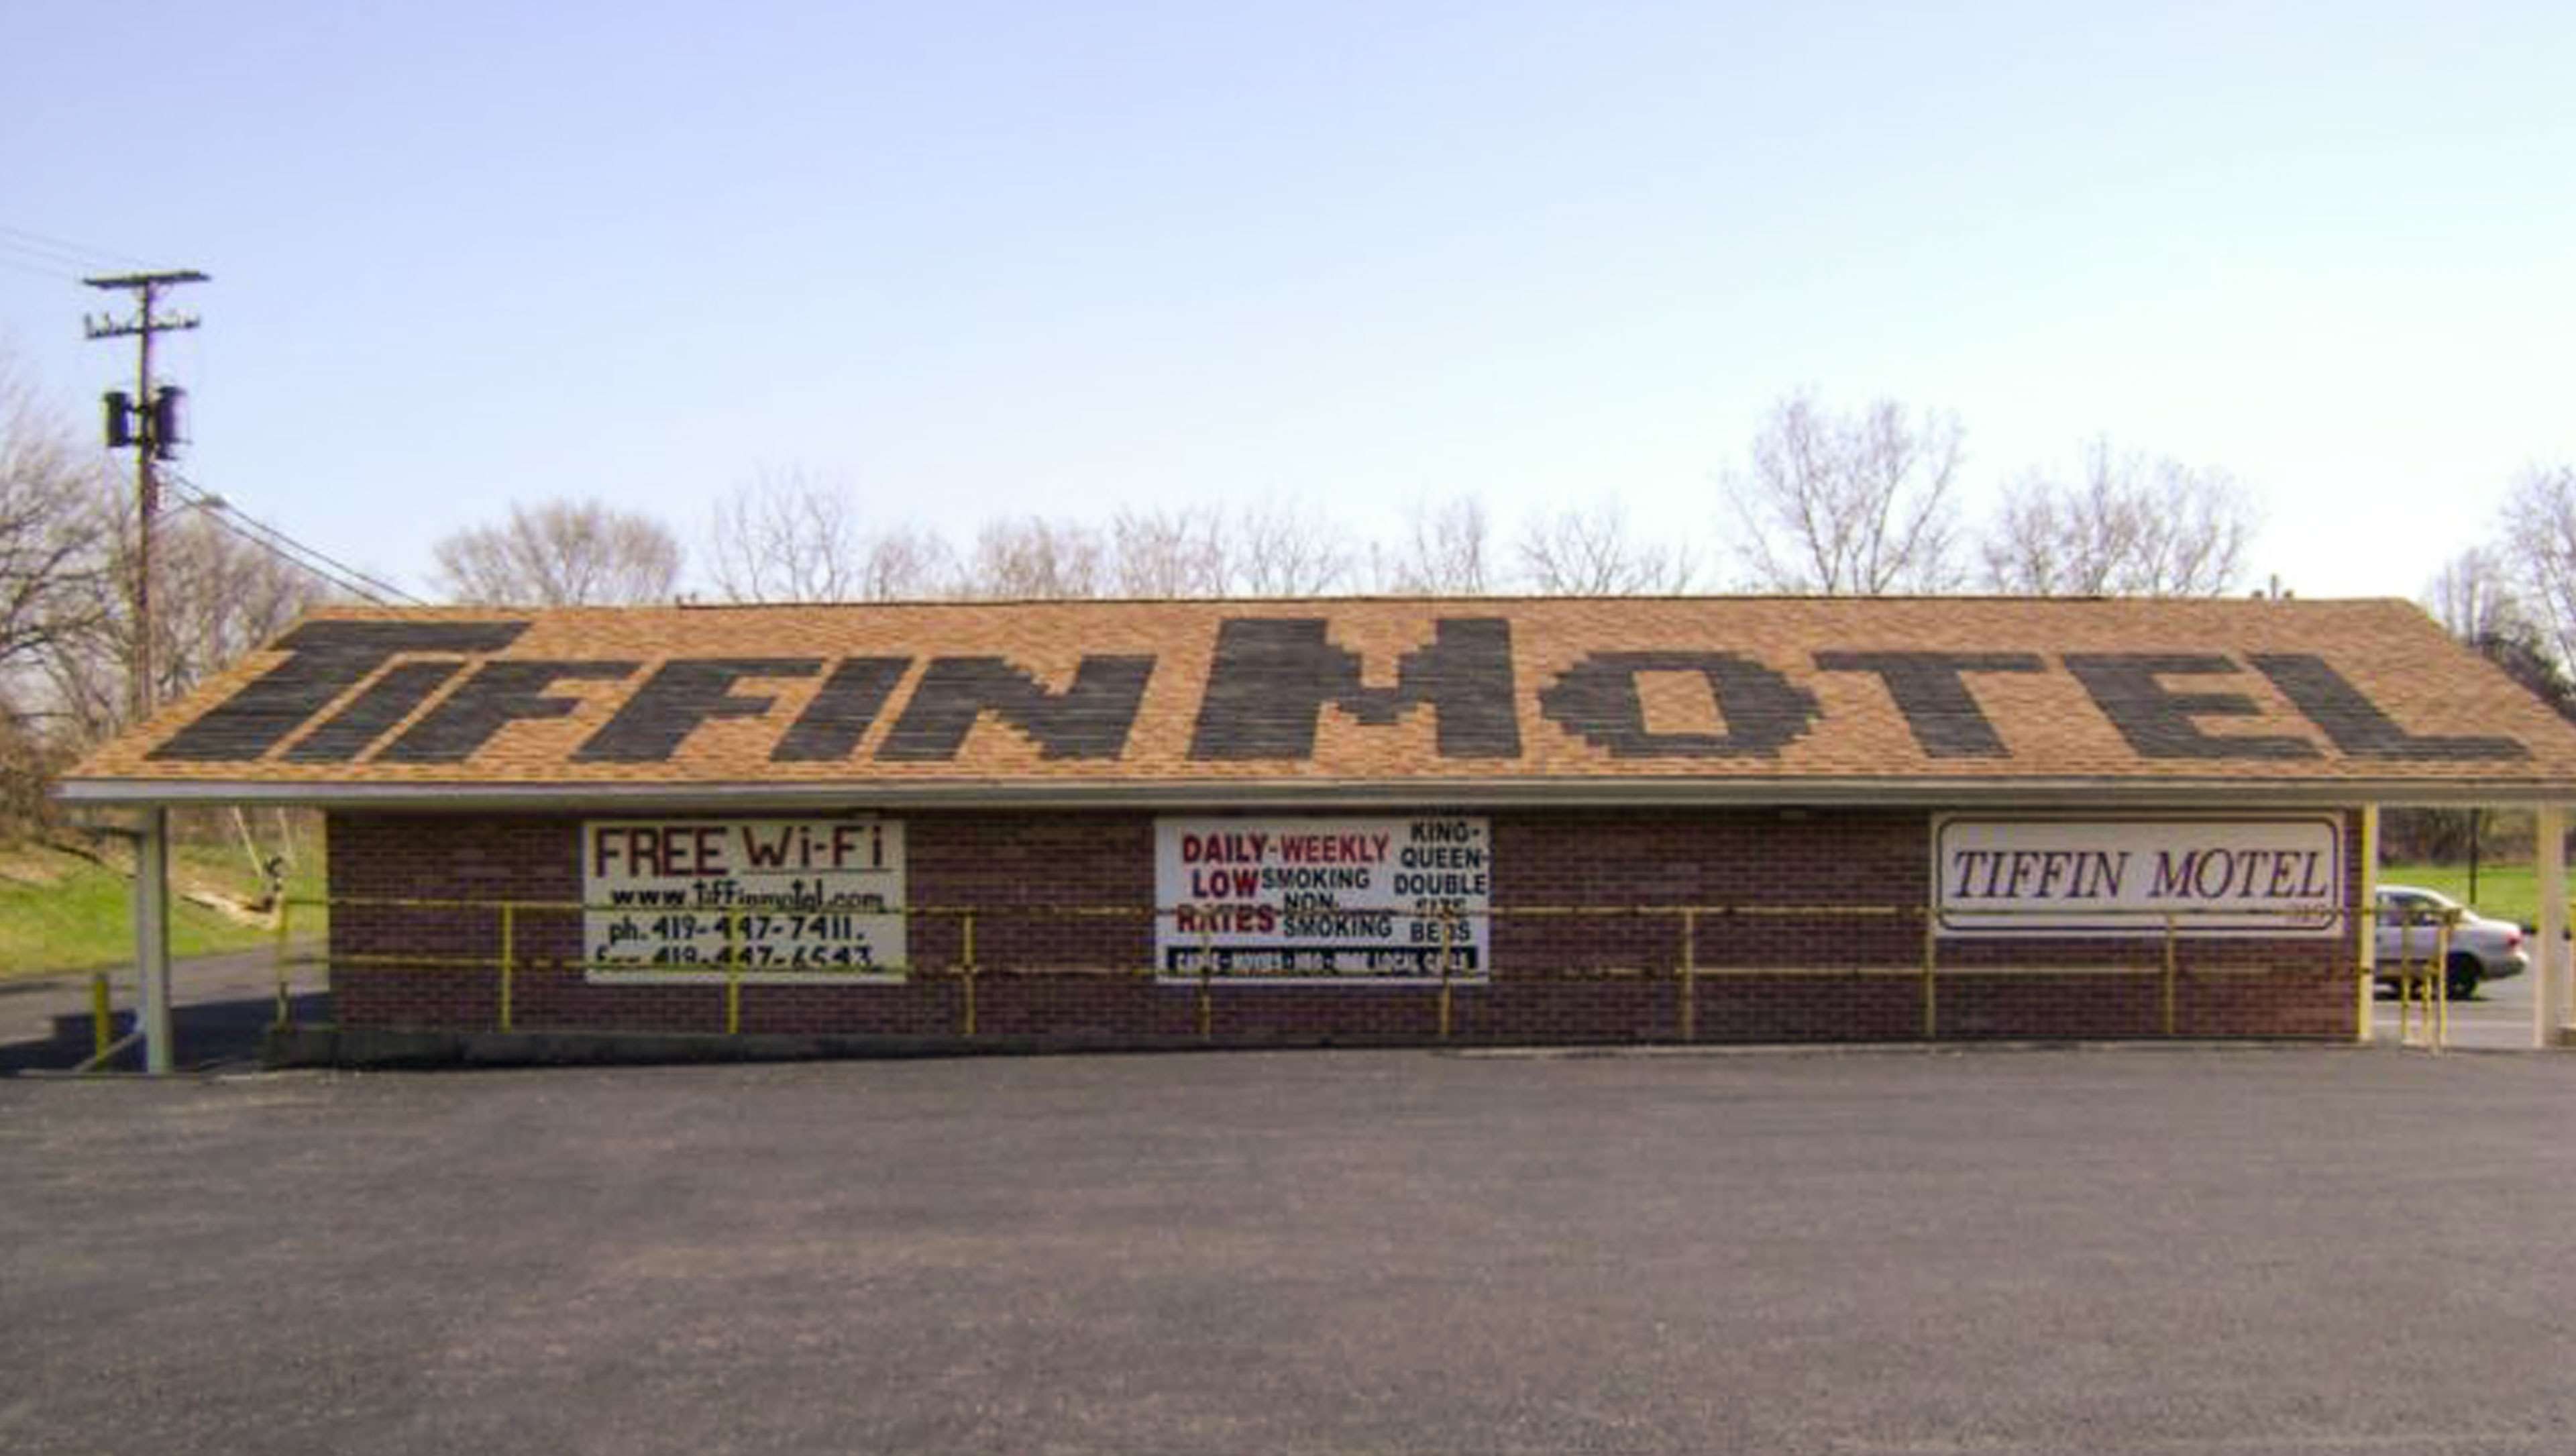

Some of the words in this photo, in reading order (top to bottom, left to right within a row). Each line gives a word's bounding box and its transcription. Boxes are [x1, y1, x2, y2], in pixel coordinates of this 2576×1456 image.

[595, 826, 729, 877] FREE
[1192, 870, 1259, 898] LOW
[1262, 868, 1371, 889] SMOKING
[1394, 874, 1486, 896] DOUBLE
[1953, 850, 2131, 899] TIFFIN
[2147, 847, 2328, 899] MOTEL
[1177, 903, 1275, 933] RATES
[1283, 915, 1393, 937] SMOKING
